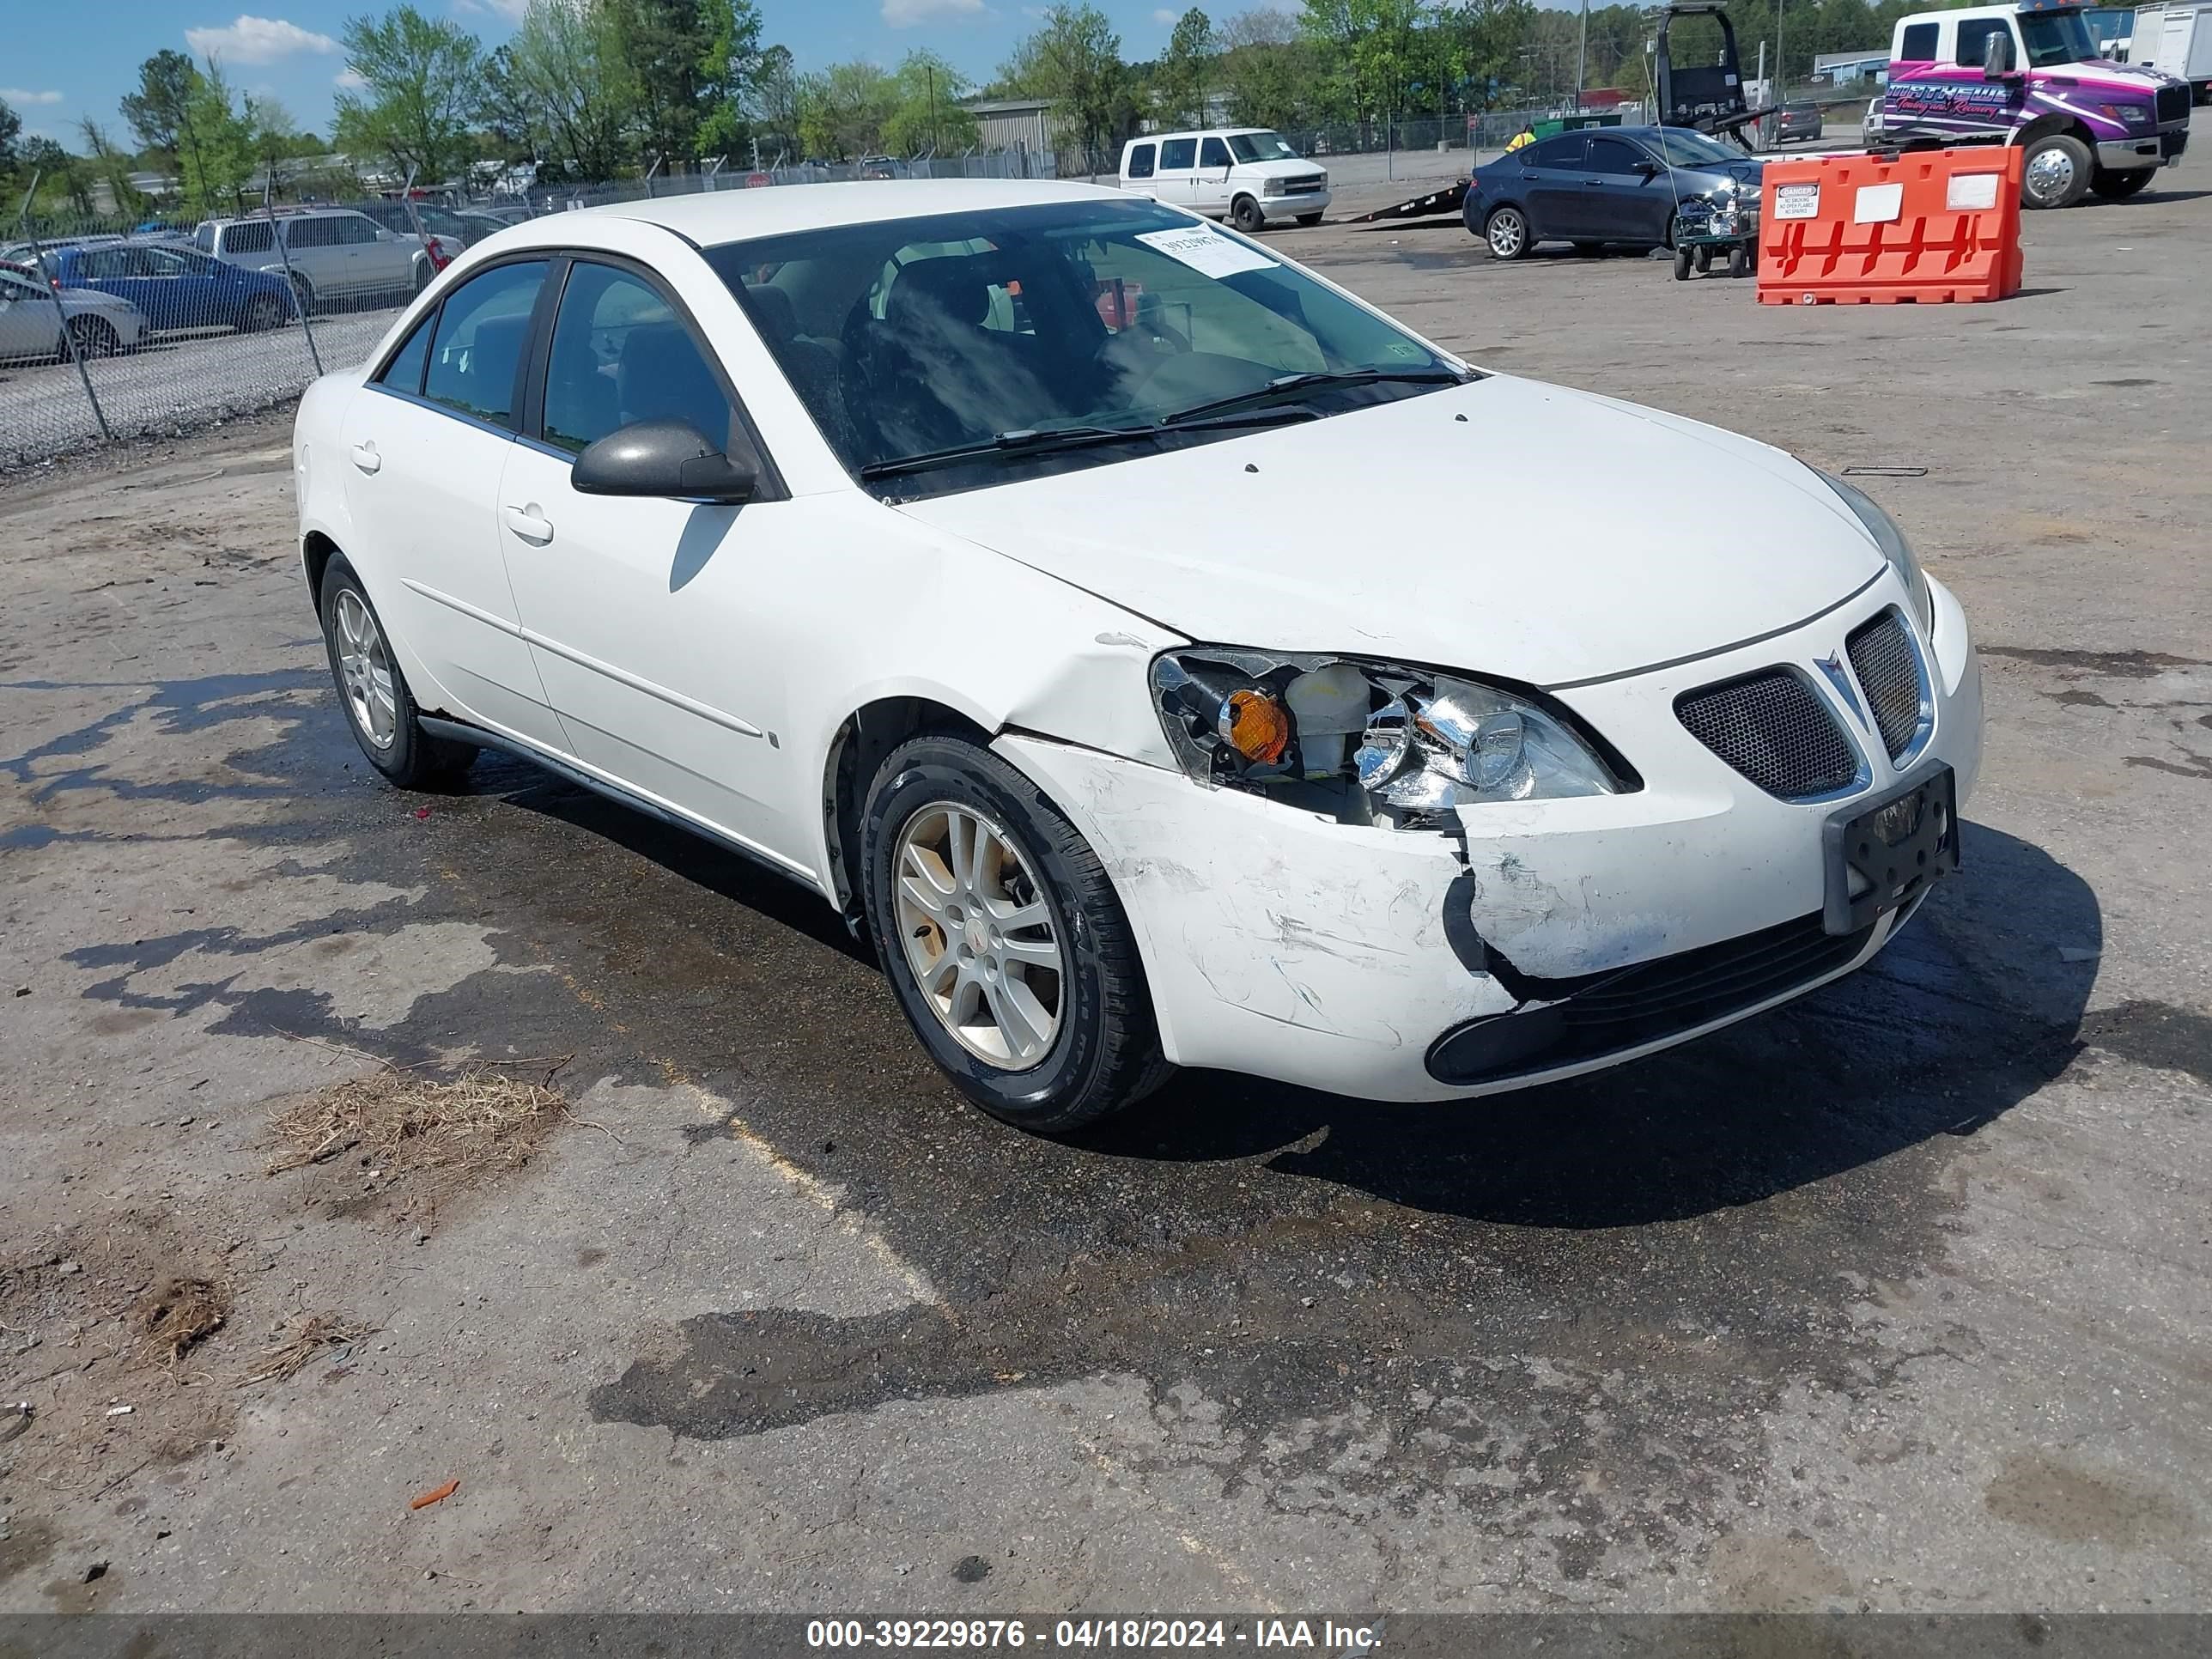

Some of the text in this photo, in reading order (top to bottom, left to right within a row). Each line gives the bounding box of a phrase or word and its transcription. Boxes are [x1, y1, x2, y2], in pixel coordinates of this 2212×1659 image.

[1897, 97, 1929, 115] Towing
[1954, 100, 2000, 121] Recovery
[1162, 235, 1225, 252] 39229876
